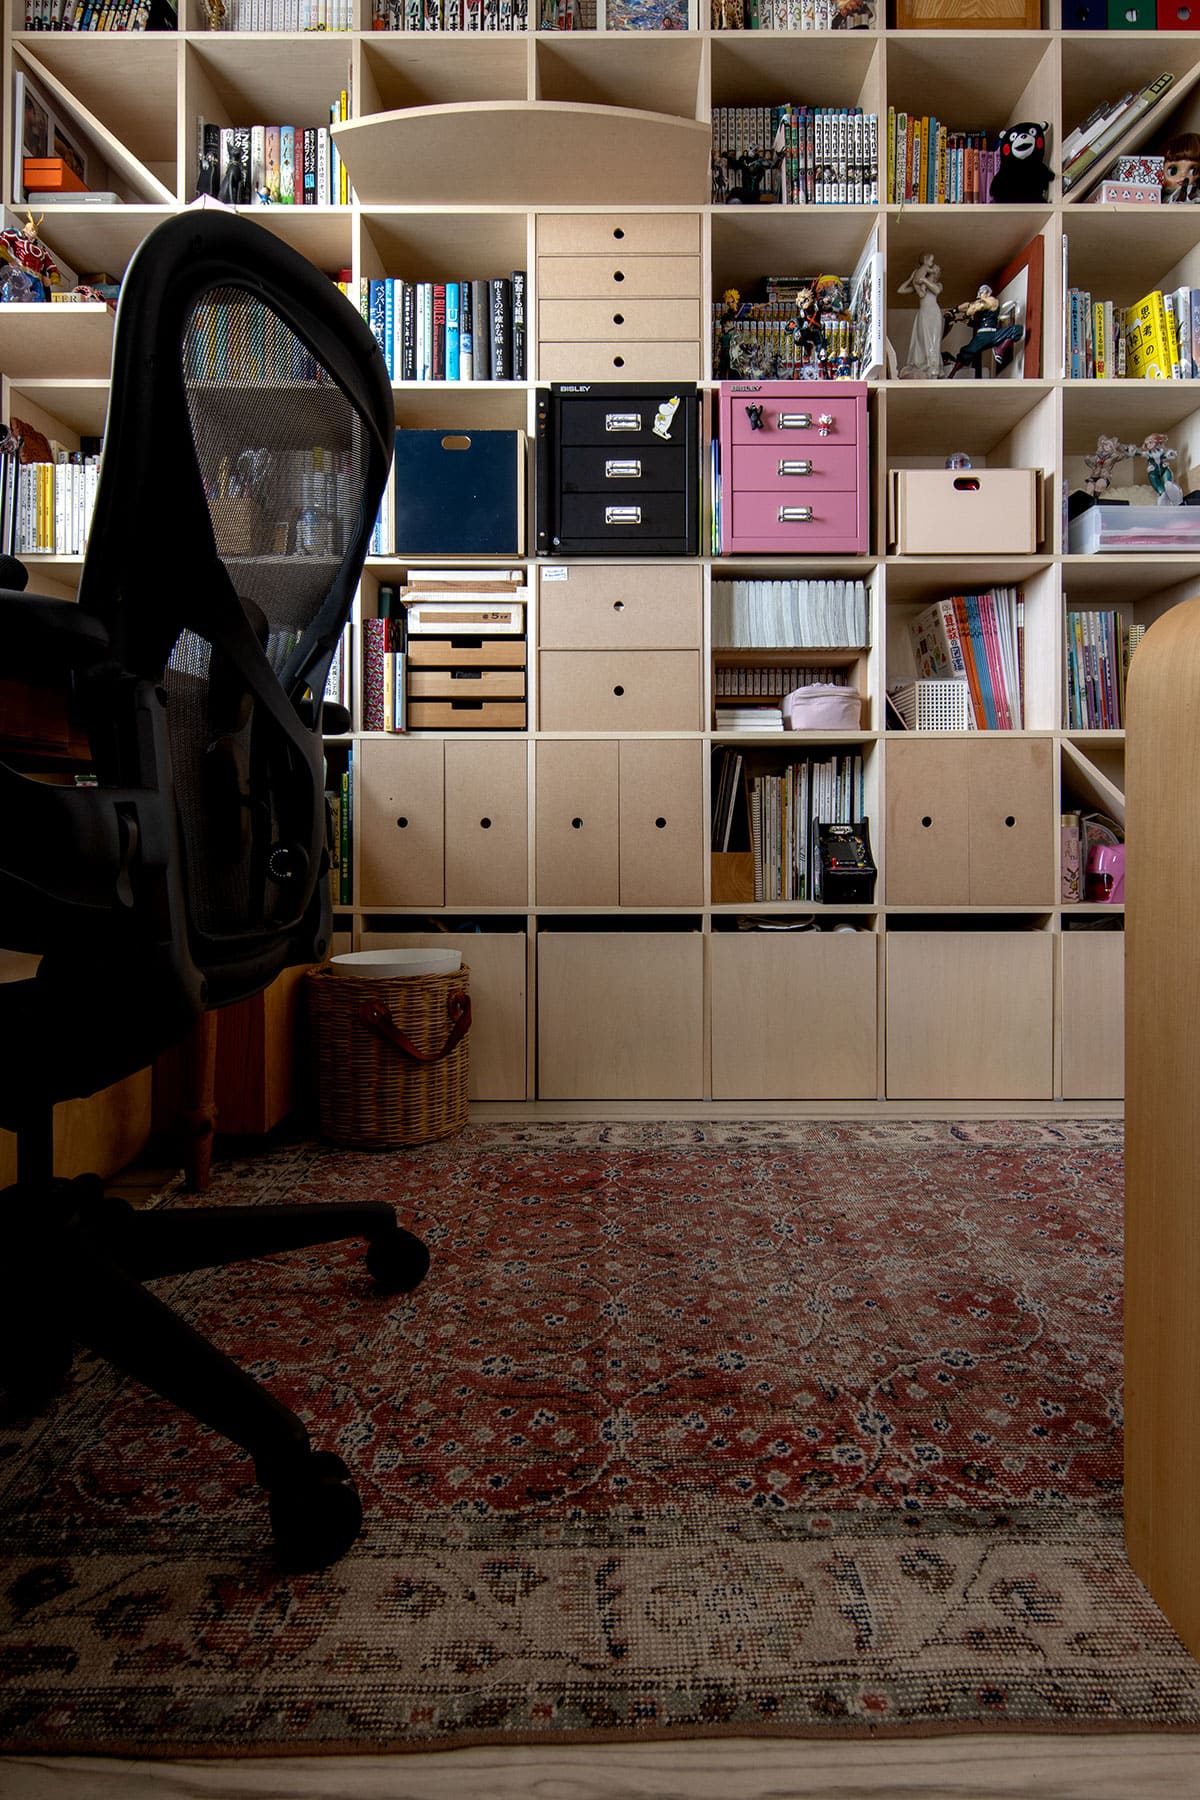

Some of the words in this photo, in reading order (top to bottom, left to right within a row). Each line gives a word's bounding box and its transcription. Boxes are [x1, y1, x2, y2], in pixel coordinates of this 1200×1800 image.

[433, 285, 445, 297] NO
[514, 275, 524, 324] 学習する組織
[433, 299, 445, 325] RULES
[494, 280, 504, 345] 街とその不確かな壁
[1139, 304, 1155, 356] 思考の
[560, 385, 591, 393] BISLEY
